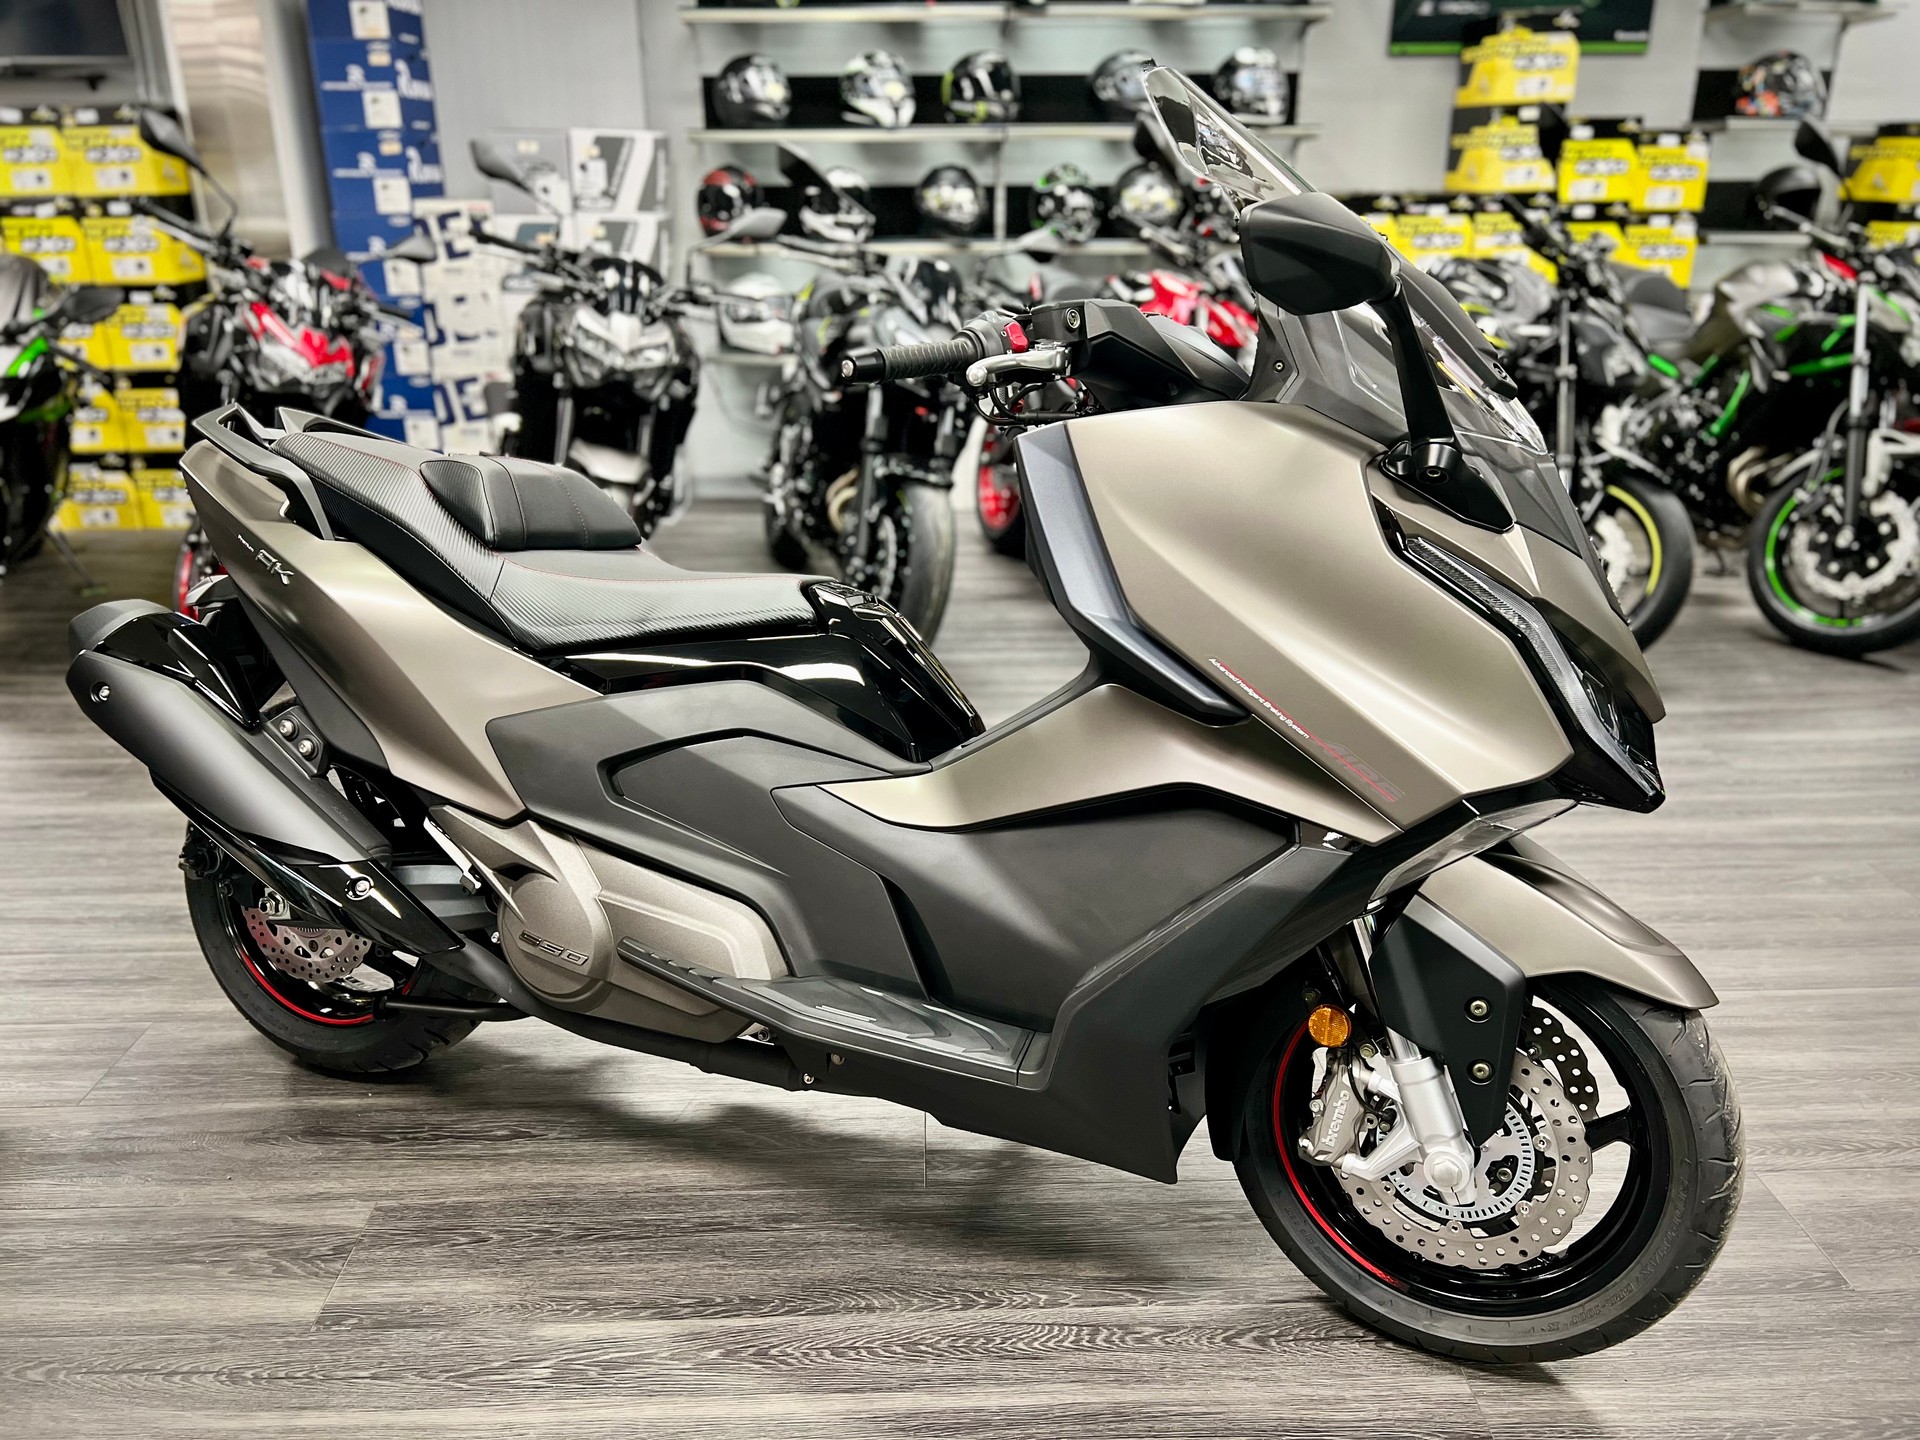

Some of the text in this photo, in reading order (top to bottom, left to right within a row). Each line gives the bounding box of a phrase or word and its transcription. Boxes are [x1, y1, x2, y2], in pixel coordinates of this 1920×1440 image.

[1208, 657, 1311, 740] Advanced Intelligent Braking System
[518, 929, 590, 967] 550
[1321, 1089, 1351, 1149] brembo
